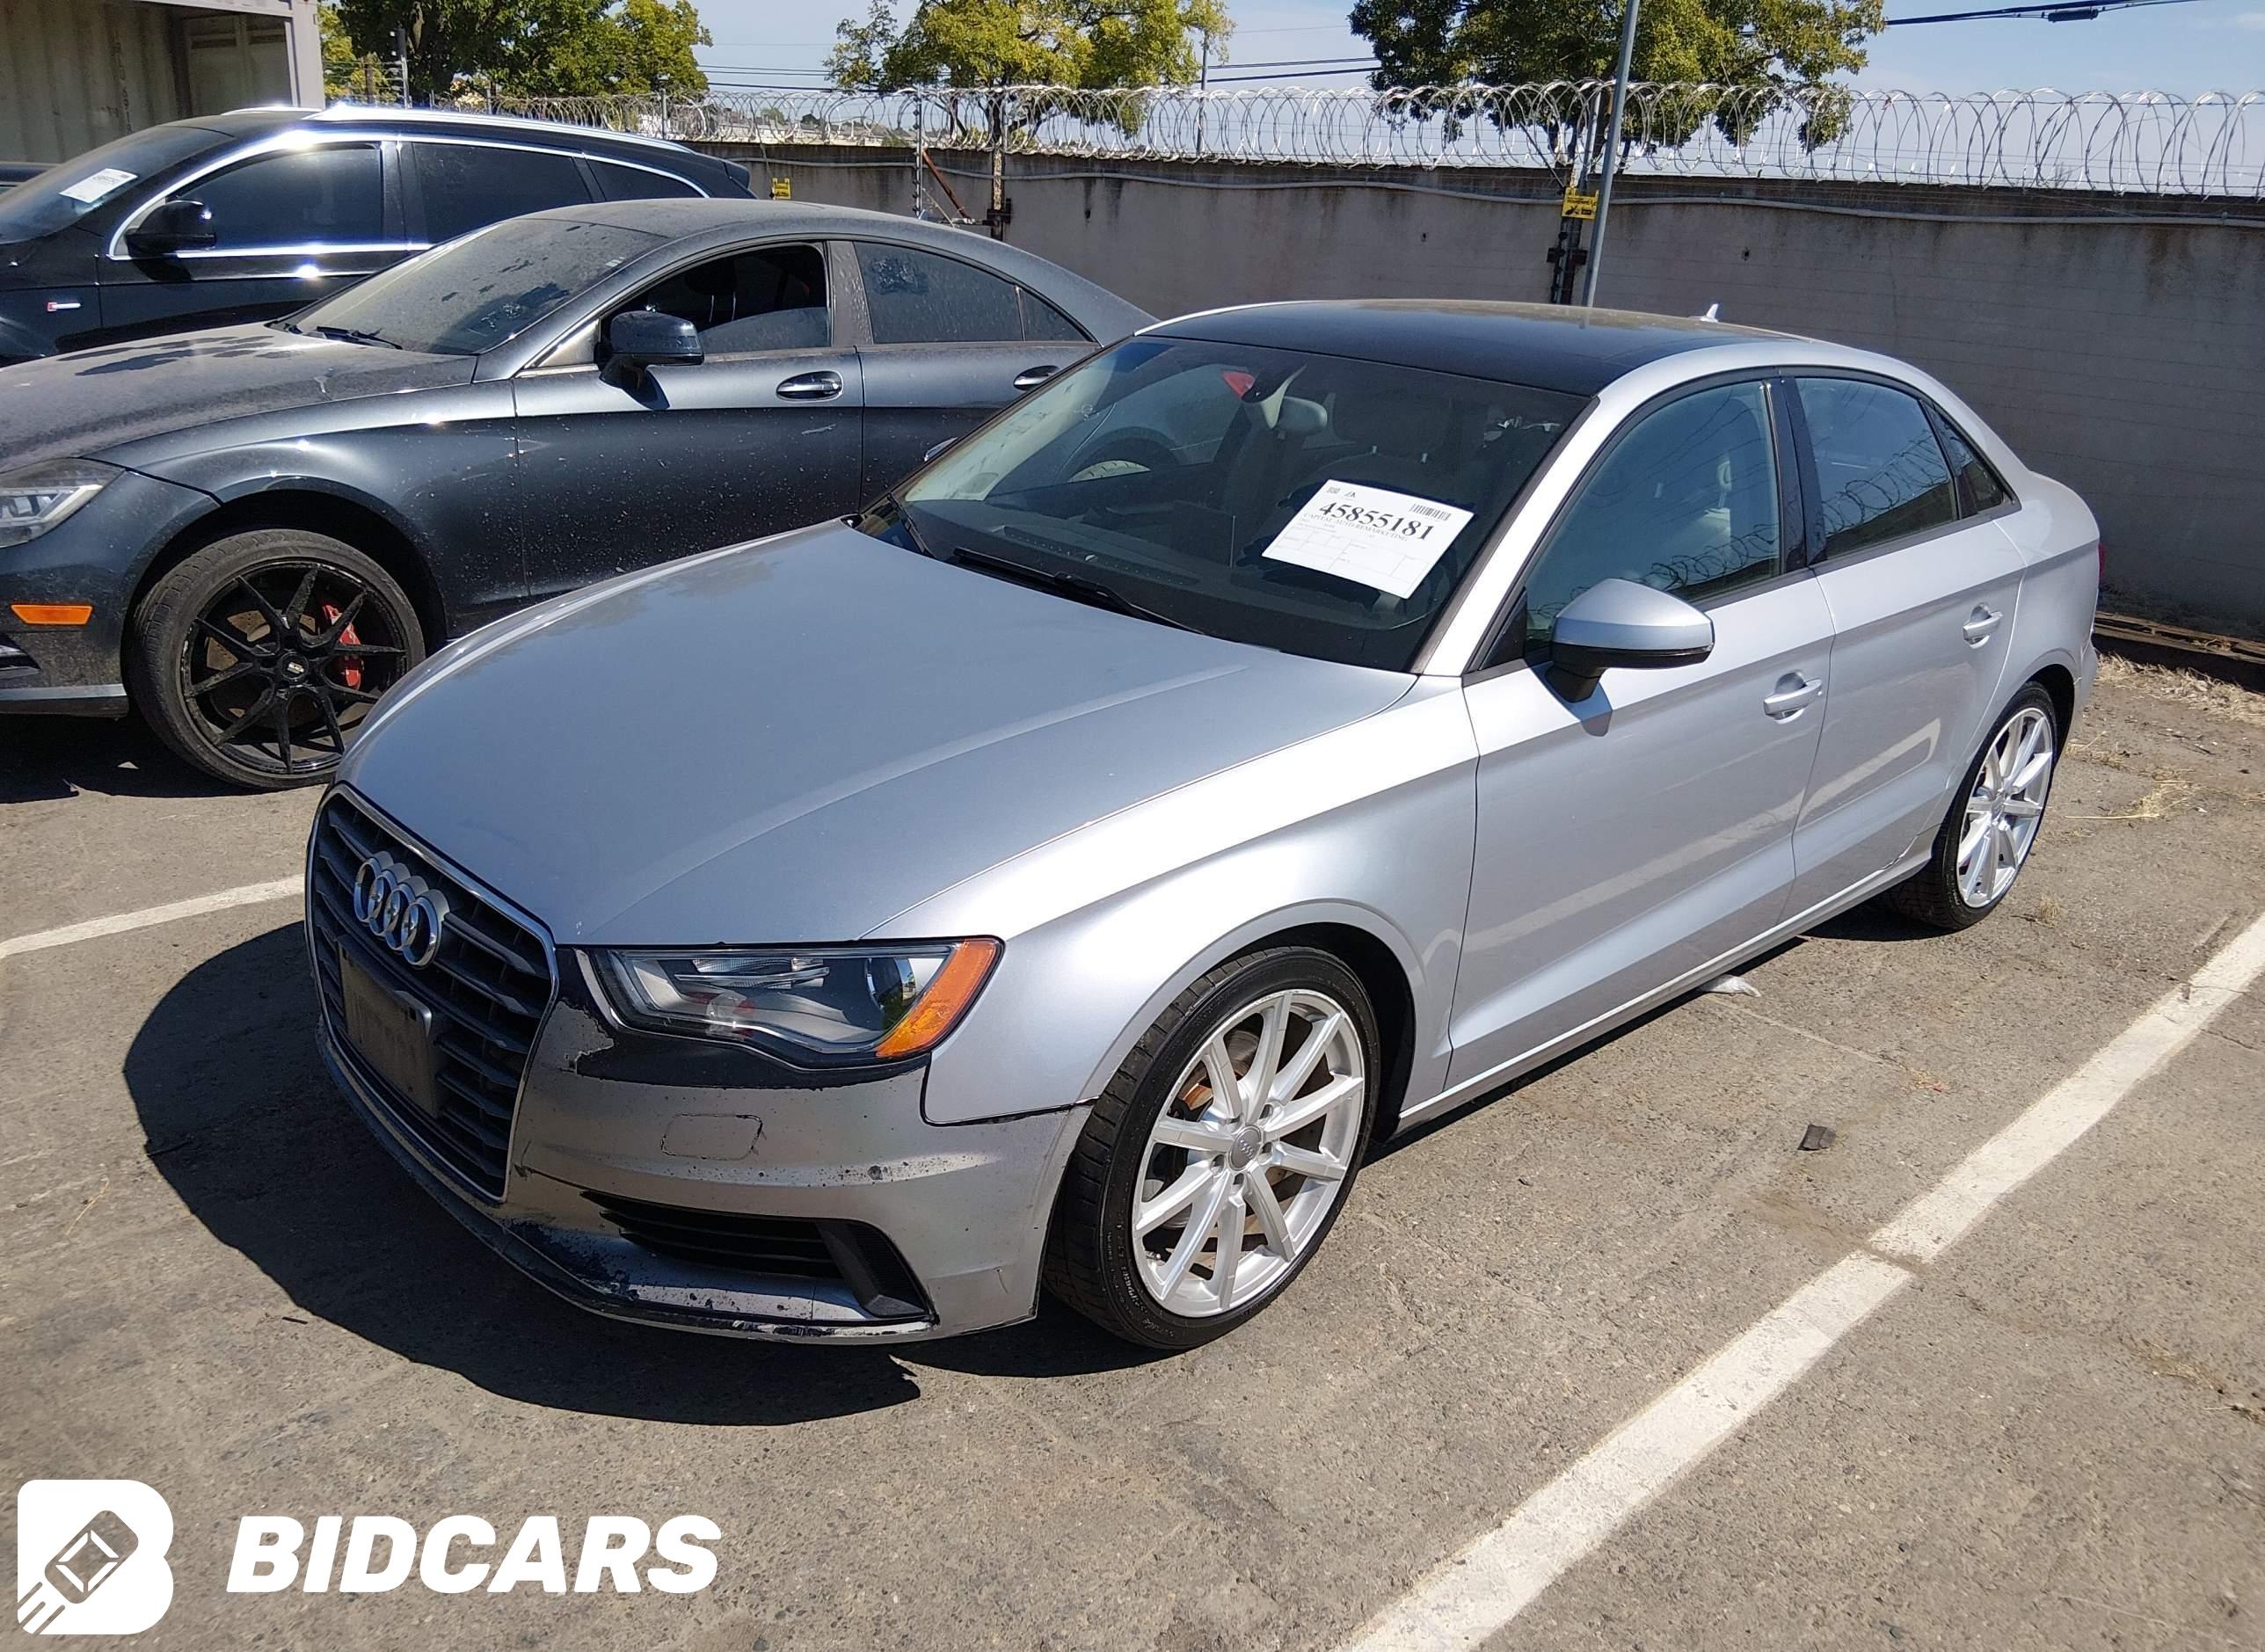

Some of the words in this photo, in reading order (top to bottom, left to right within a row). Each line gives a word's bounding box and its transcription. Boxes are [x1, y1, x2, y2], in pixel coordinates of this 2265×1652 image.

[1302, 512, 1333, 524] CAPITAL
[1334, 519, 1355, 528] AUTO
[1354, 524, 1409, 542] REMARKETING
[1319, 501, 1435, 540] 45855181
